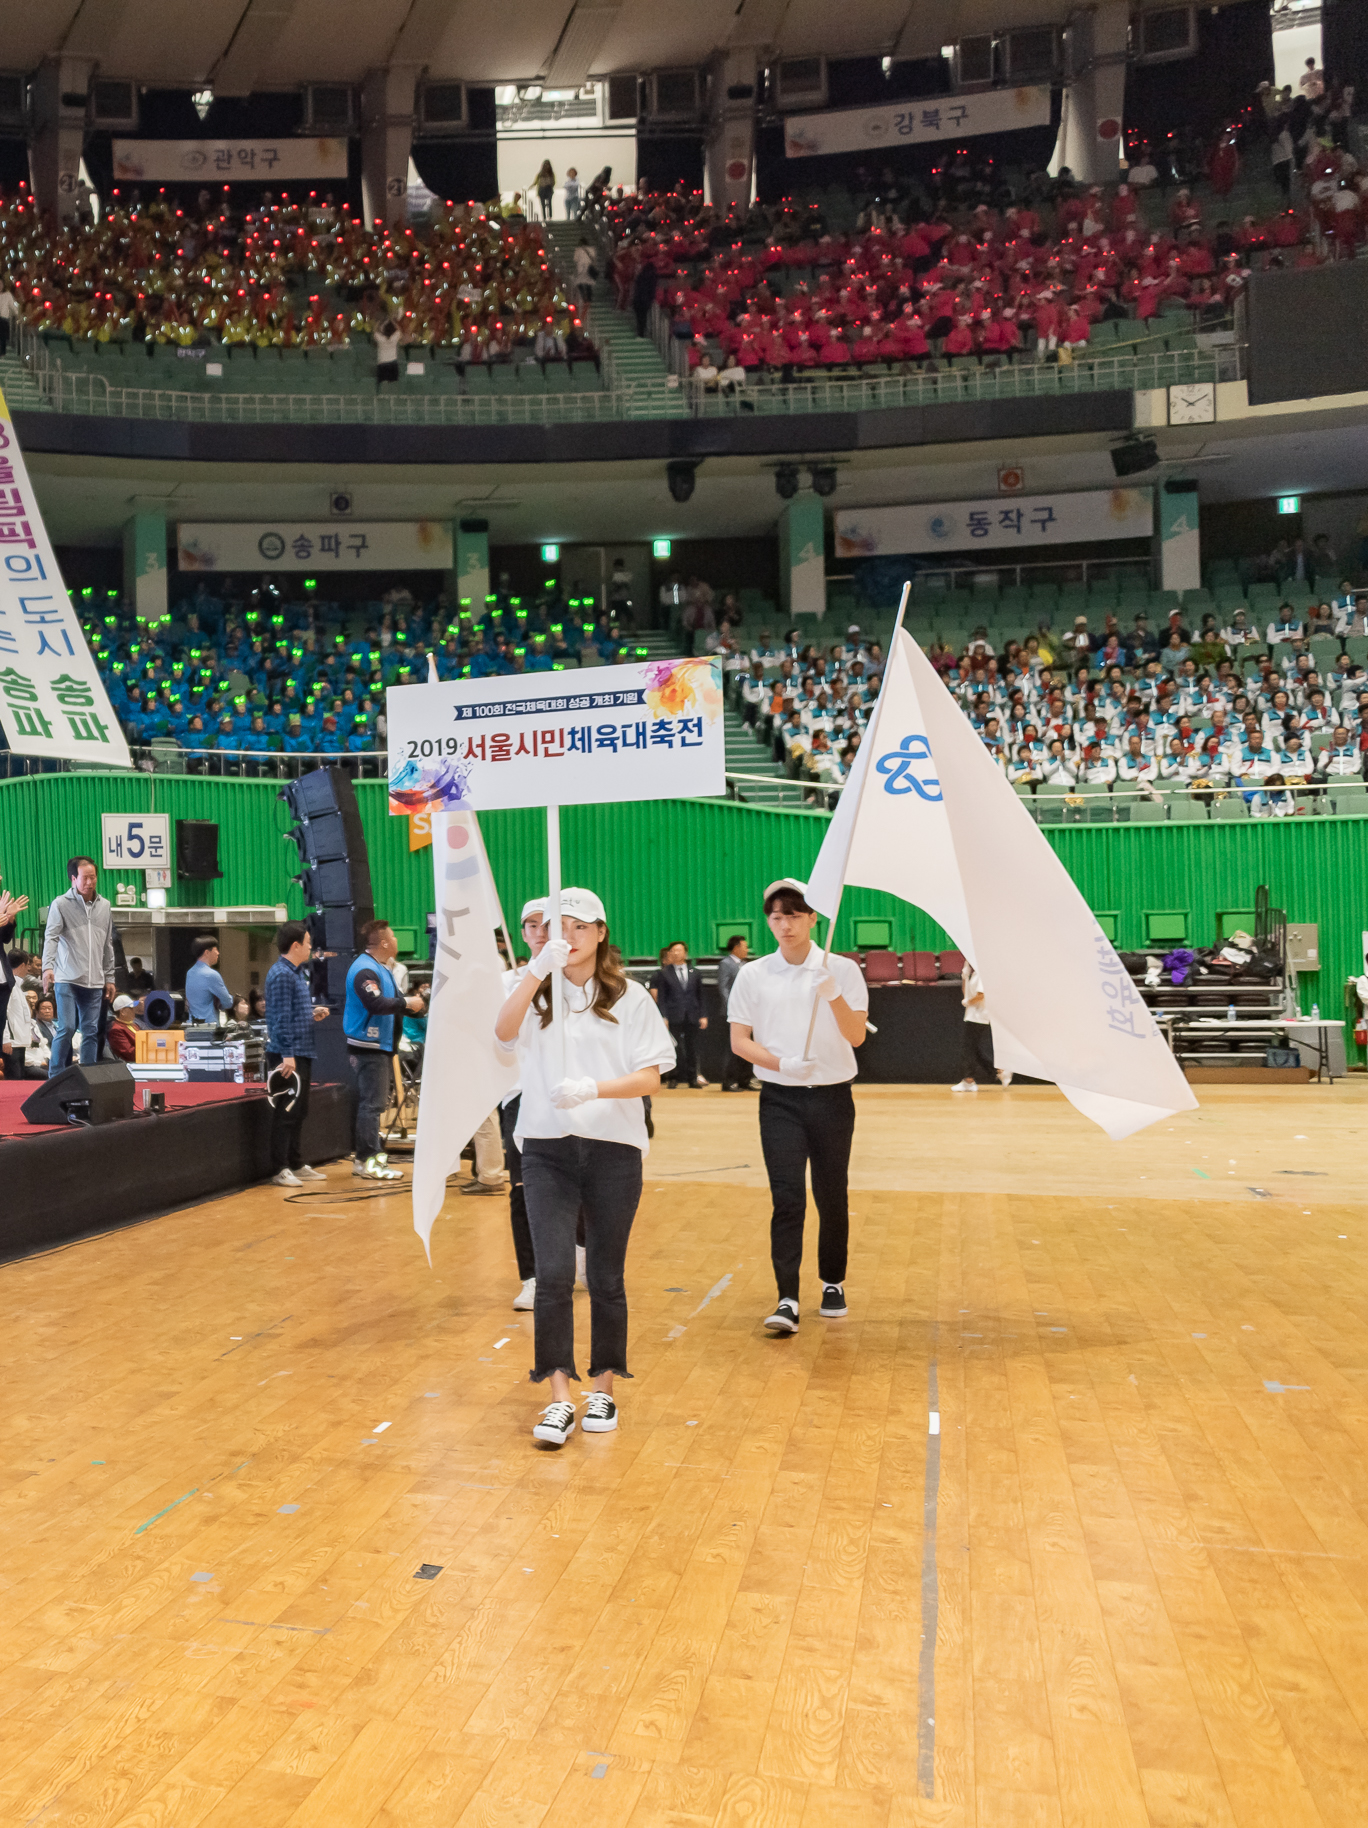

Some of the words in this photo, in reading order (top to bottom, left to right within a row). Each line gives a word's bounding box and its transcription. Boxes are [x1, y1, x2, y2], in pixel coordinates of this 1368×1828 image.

[894, 105, 969, 135] 강북구
[213, 148, 281, 170] 관악구
[966, 507, 1057, 537] 동작구
[291, 533, 369, 559] 송파구
[18, 595, 75, 657] 도시
[49, 672, 110, 743] 송파
[461, 707, 472, 718] 제
[474, 705, 504, 717] 100회
[505, 700, 566, 715] 전국체육대회
[569, 697, 590, 709] 성공
[592, 694, 614, 706] 개최
[616, 692, 638, 704] 기원
[407, 737, 458, 759] 2019
[413, 812, 432, 835] S
